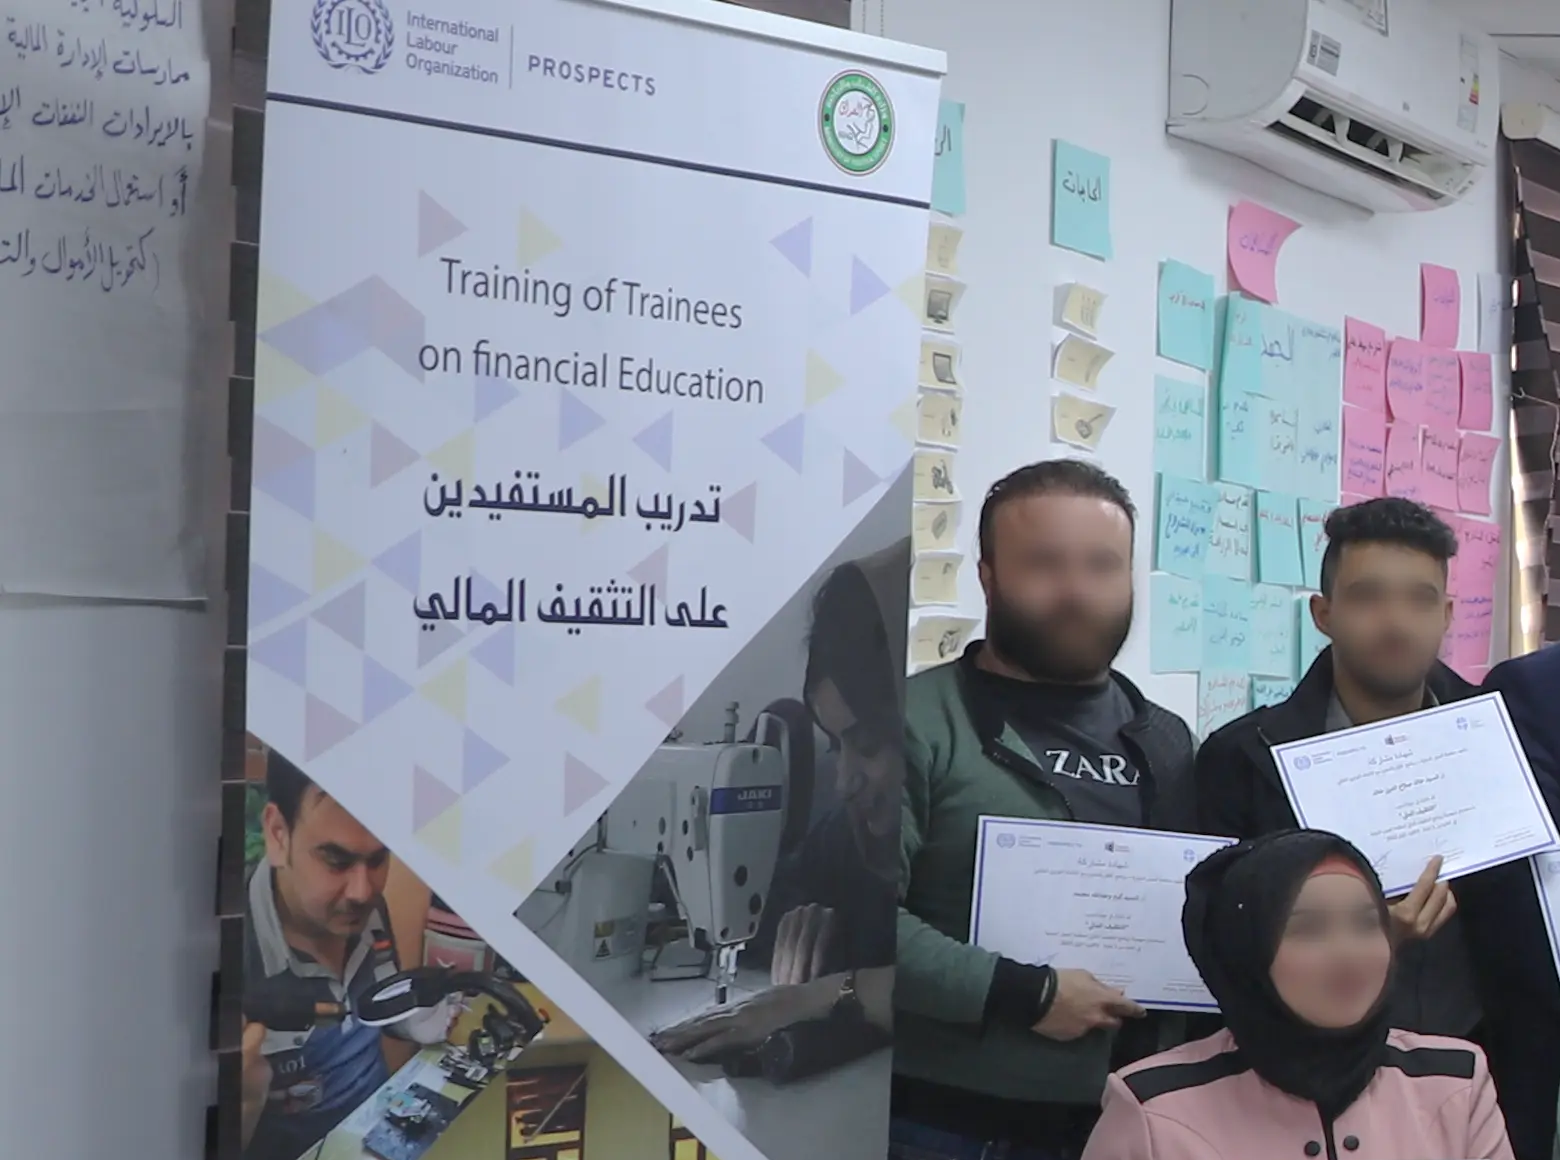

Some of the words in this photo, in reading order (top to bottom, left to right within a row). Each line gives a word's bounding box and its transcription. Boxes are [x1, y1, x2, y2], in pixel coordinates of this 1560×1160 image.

[406, 32, 458, 56] Labour
[407, 10, 499, 42] International
[405, 52, 498, 84] Organization
[527, 54, 657, 96] PROSPECTS
[440, 257, 572, 317] Training
[583, 278, 618, 313] of
[622, 281, 743, 330] Trainees
[418, 344, 461, 373] on
[473, 340, 608, 389] financial
[618, 357, 764, 404] Education
[423, 470, 627, 521] المستفيدين
[636, 484, 722, 532] تدريب
[413, 574, 526, 632] المالي
[537, 579, 656, 636] التثقيف
[664, 585, 729, 629] على
